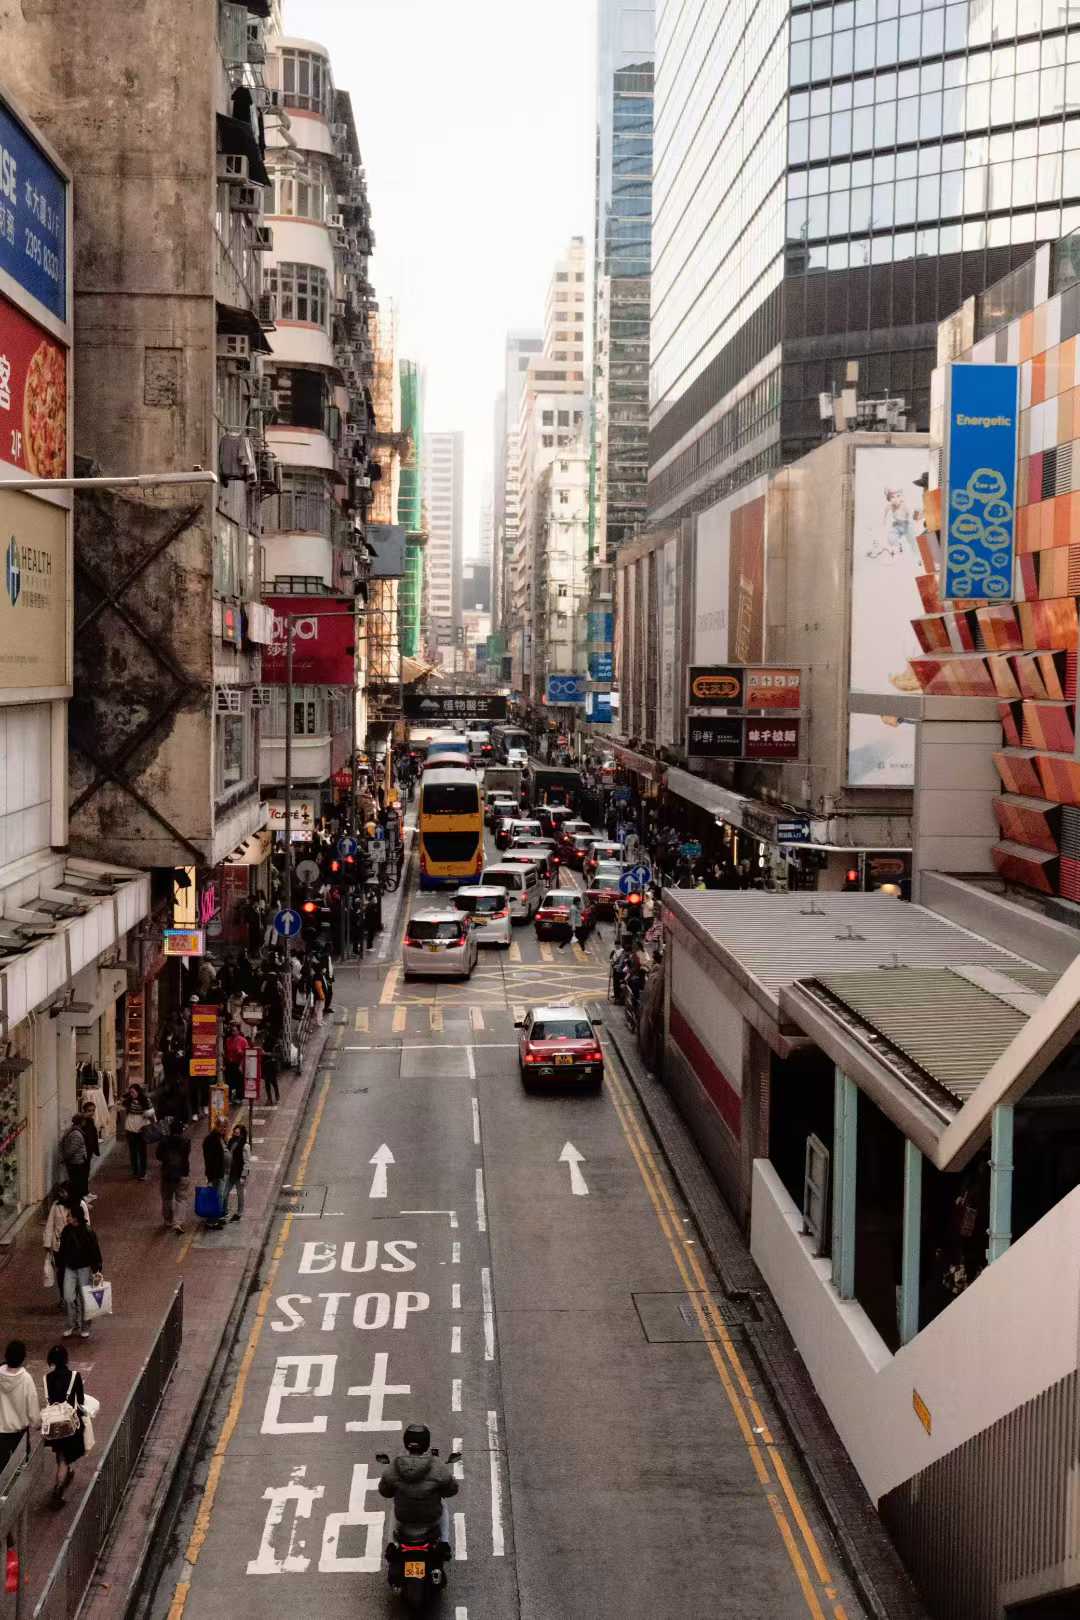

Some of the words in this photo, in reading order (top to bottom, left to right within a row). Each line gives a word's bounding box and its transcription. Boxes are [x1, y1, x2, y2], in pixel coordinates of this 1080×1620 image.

[0, 143, 17, 206] SE
[956, 414, 1011, 428] Energetic
[11, 429, 21, 462] 2/F
[21, 545, 52, 576] HEALTH
[299, 1240, 417, 1274] BUS
[271, 1291, 430, 1332] STOP
[260, 1353, 411, 1434] 巴士
[246, 1464, 386, 1575] 站
